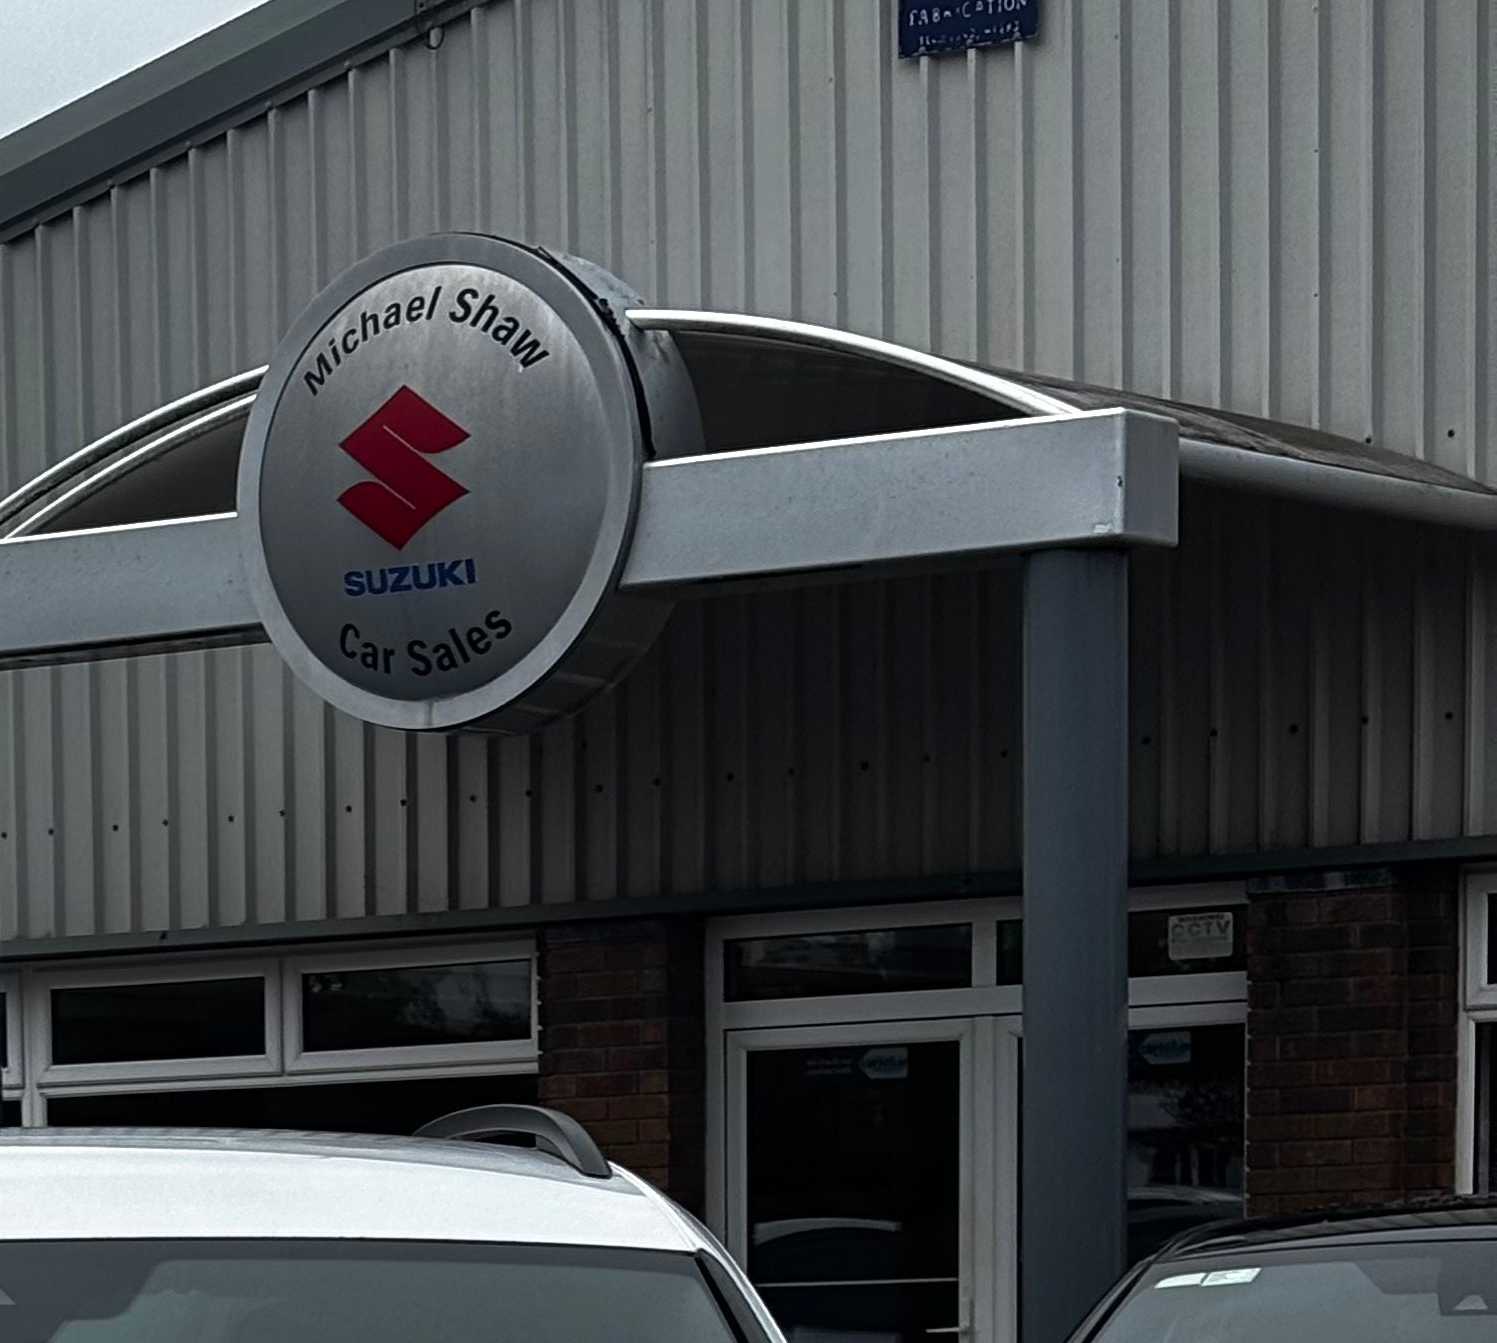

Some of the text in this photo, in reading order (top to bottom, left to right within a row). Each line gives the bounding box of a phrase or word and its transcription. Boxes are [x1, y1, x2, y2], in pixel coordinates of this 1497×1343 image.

[302, 286, 551, 397] Michael Shaw
[343, 558, 476, 597] SUZUKI
[339, 609, 513, 677] Car Sales
